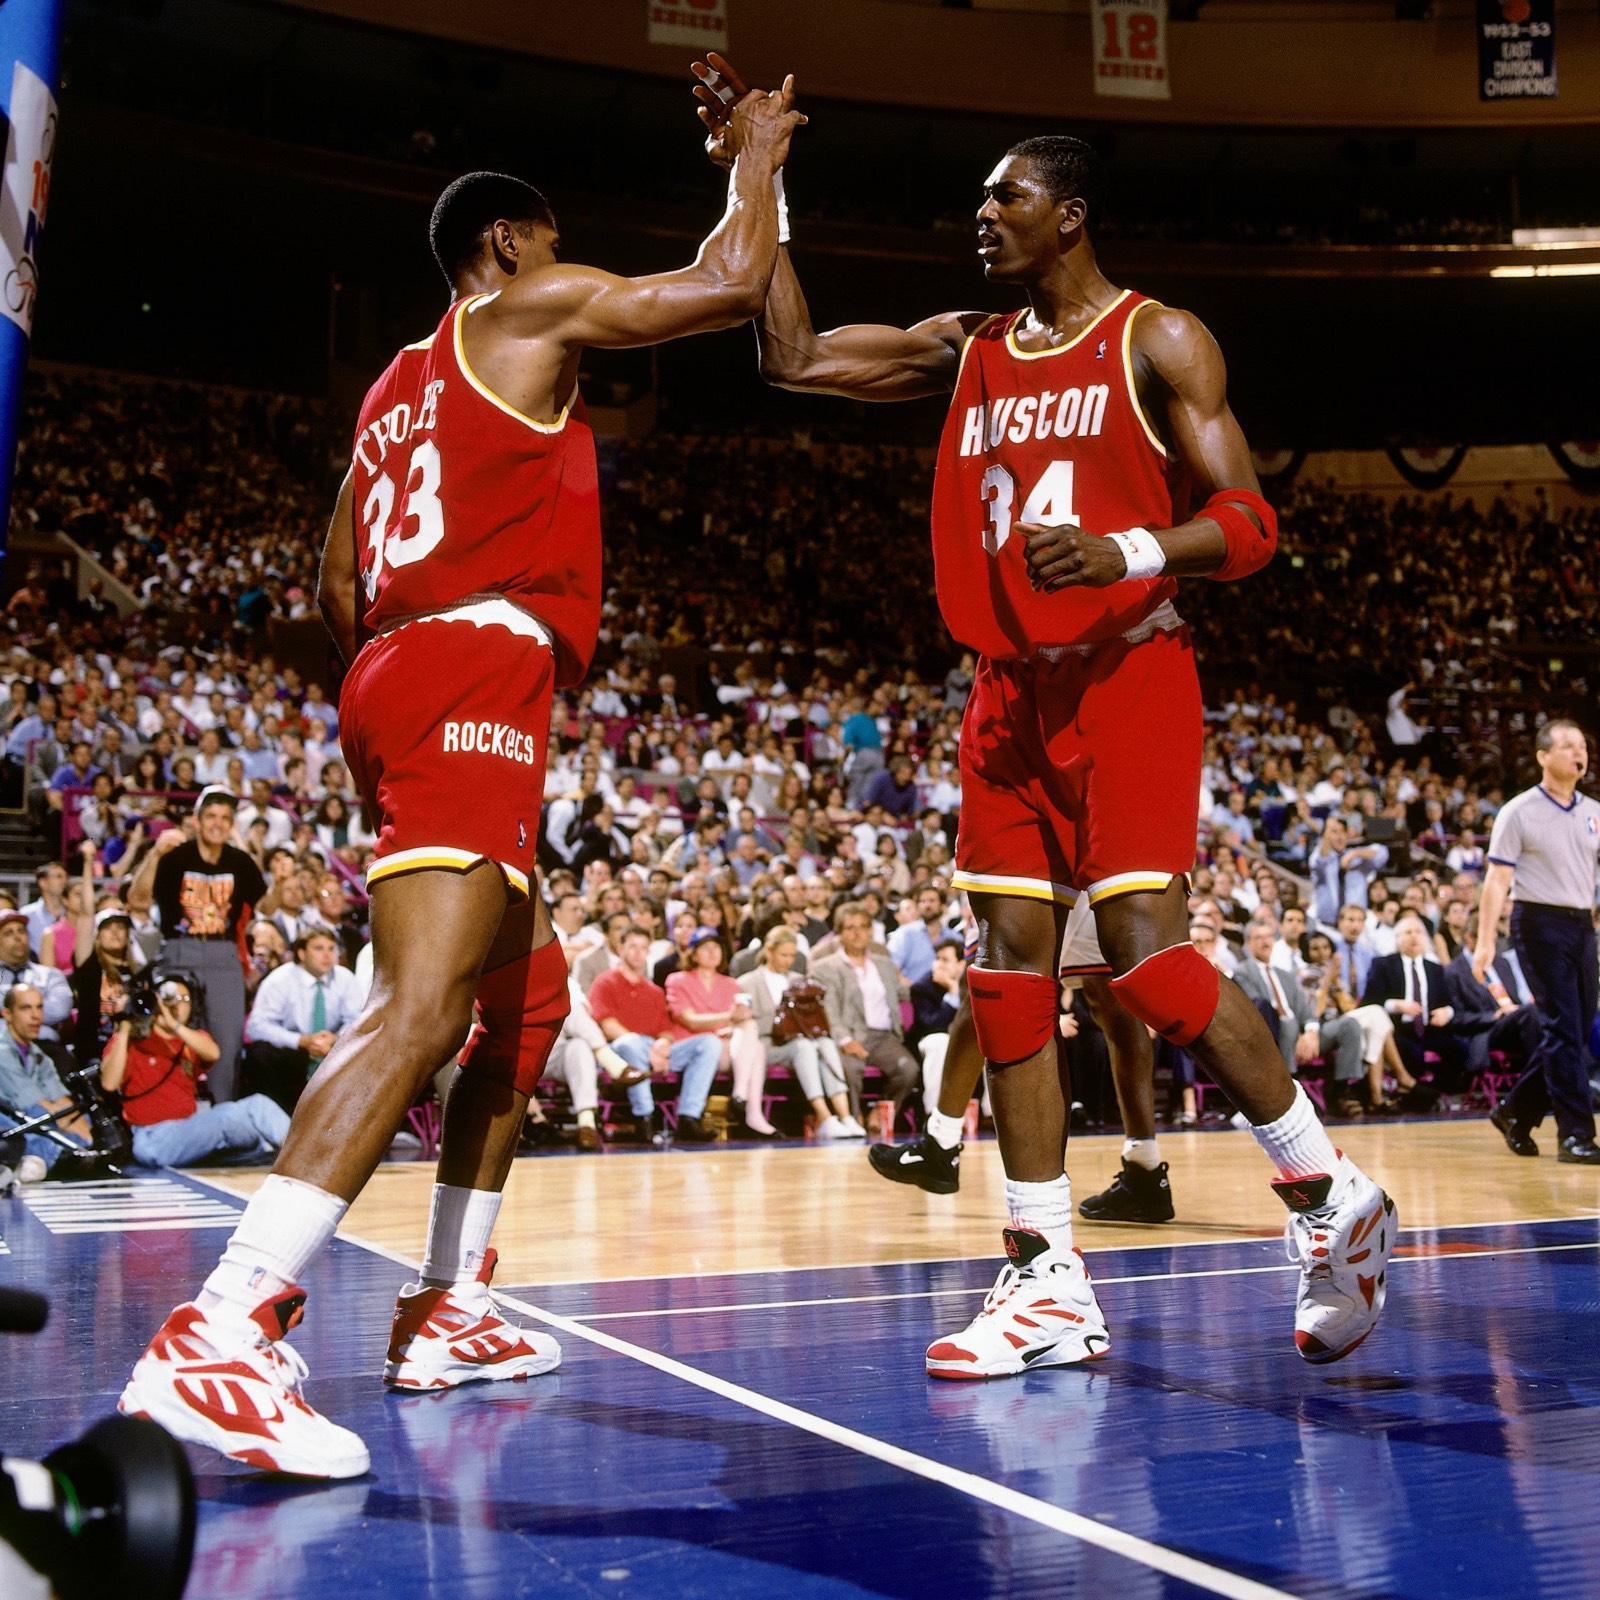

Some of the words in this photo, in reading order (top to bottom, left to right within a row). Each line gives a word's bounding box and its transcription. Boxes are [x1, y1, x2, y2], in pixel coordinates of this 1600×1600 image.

[1102, 11, 1157, 60] 12
[353, 380, 445, 477] THOPE
[362, 438, 445, 603] 33
[981, 460, 1081, 558] 34
